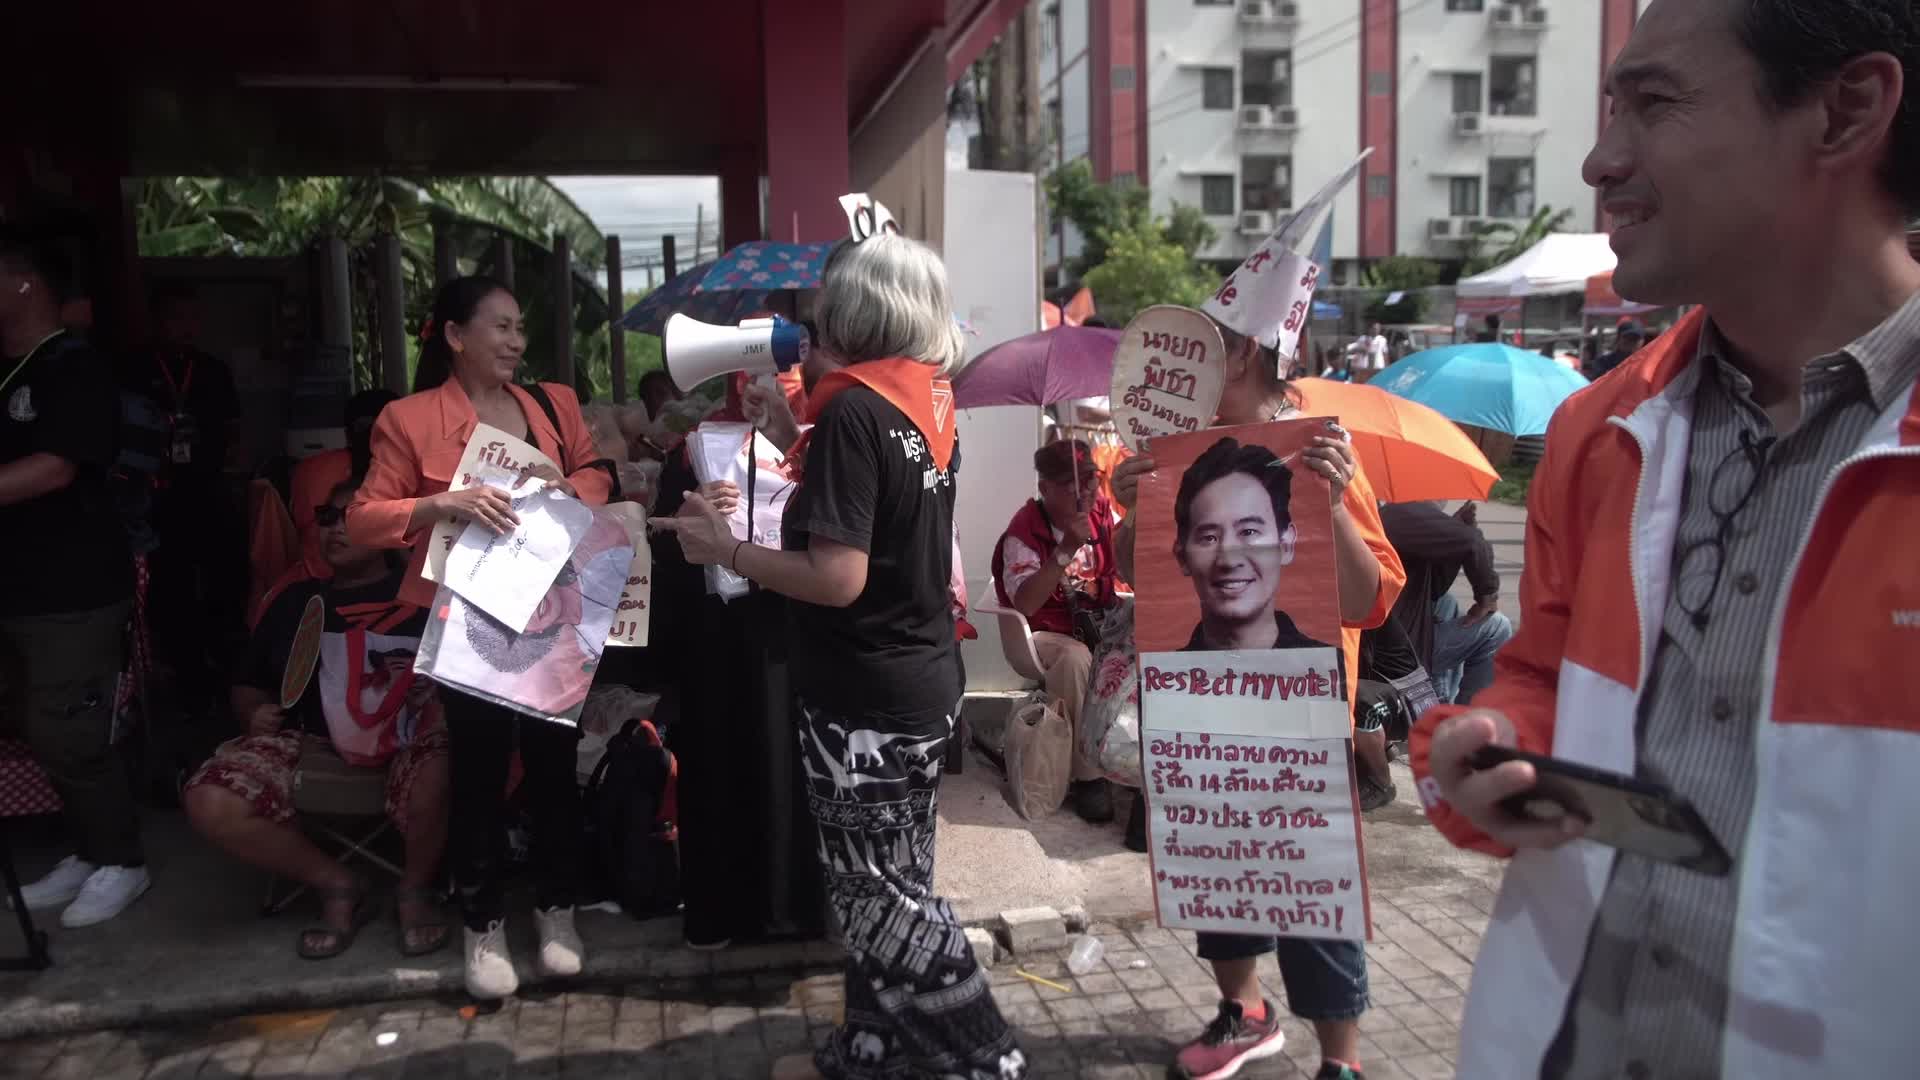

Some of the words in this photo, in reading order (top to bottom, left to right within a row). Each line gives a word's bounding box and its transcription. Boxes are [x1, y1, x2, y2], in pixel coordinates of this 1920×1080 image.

[742, 343, 766, 355] JMF
[1142, 331, 1206, 363] นายก
[1144, 356, 1197, 399] พิธา
